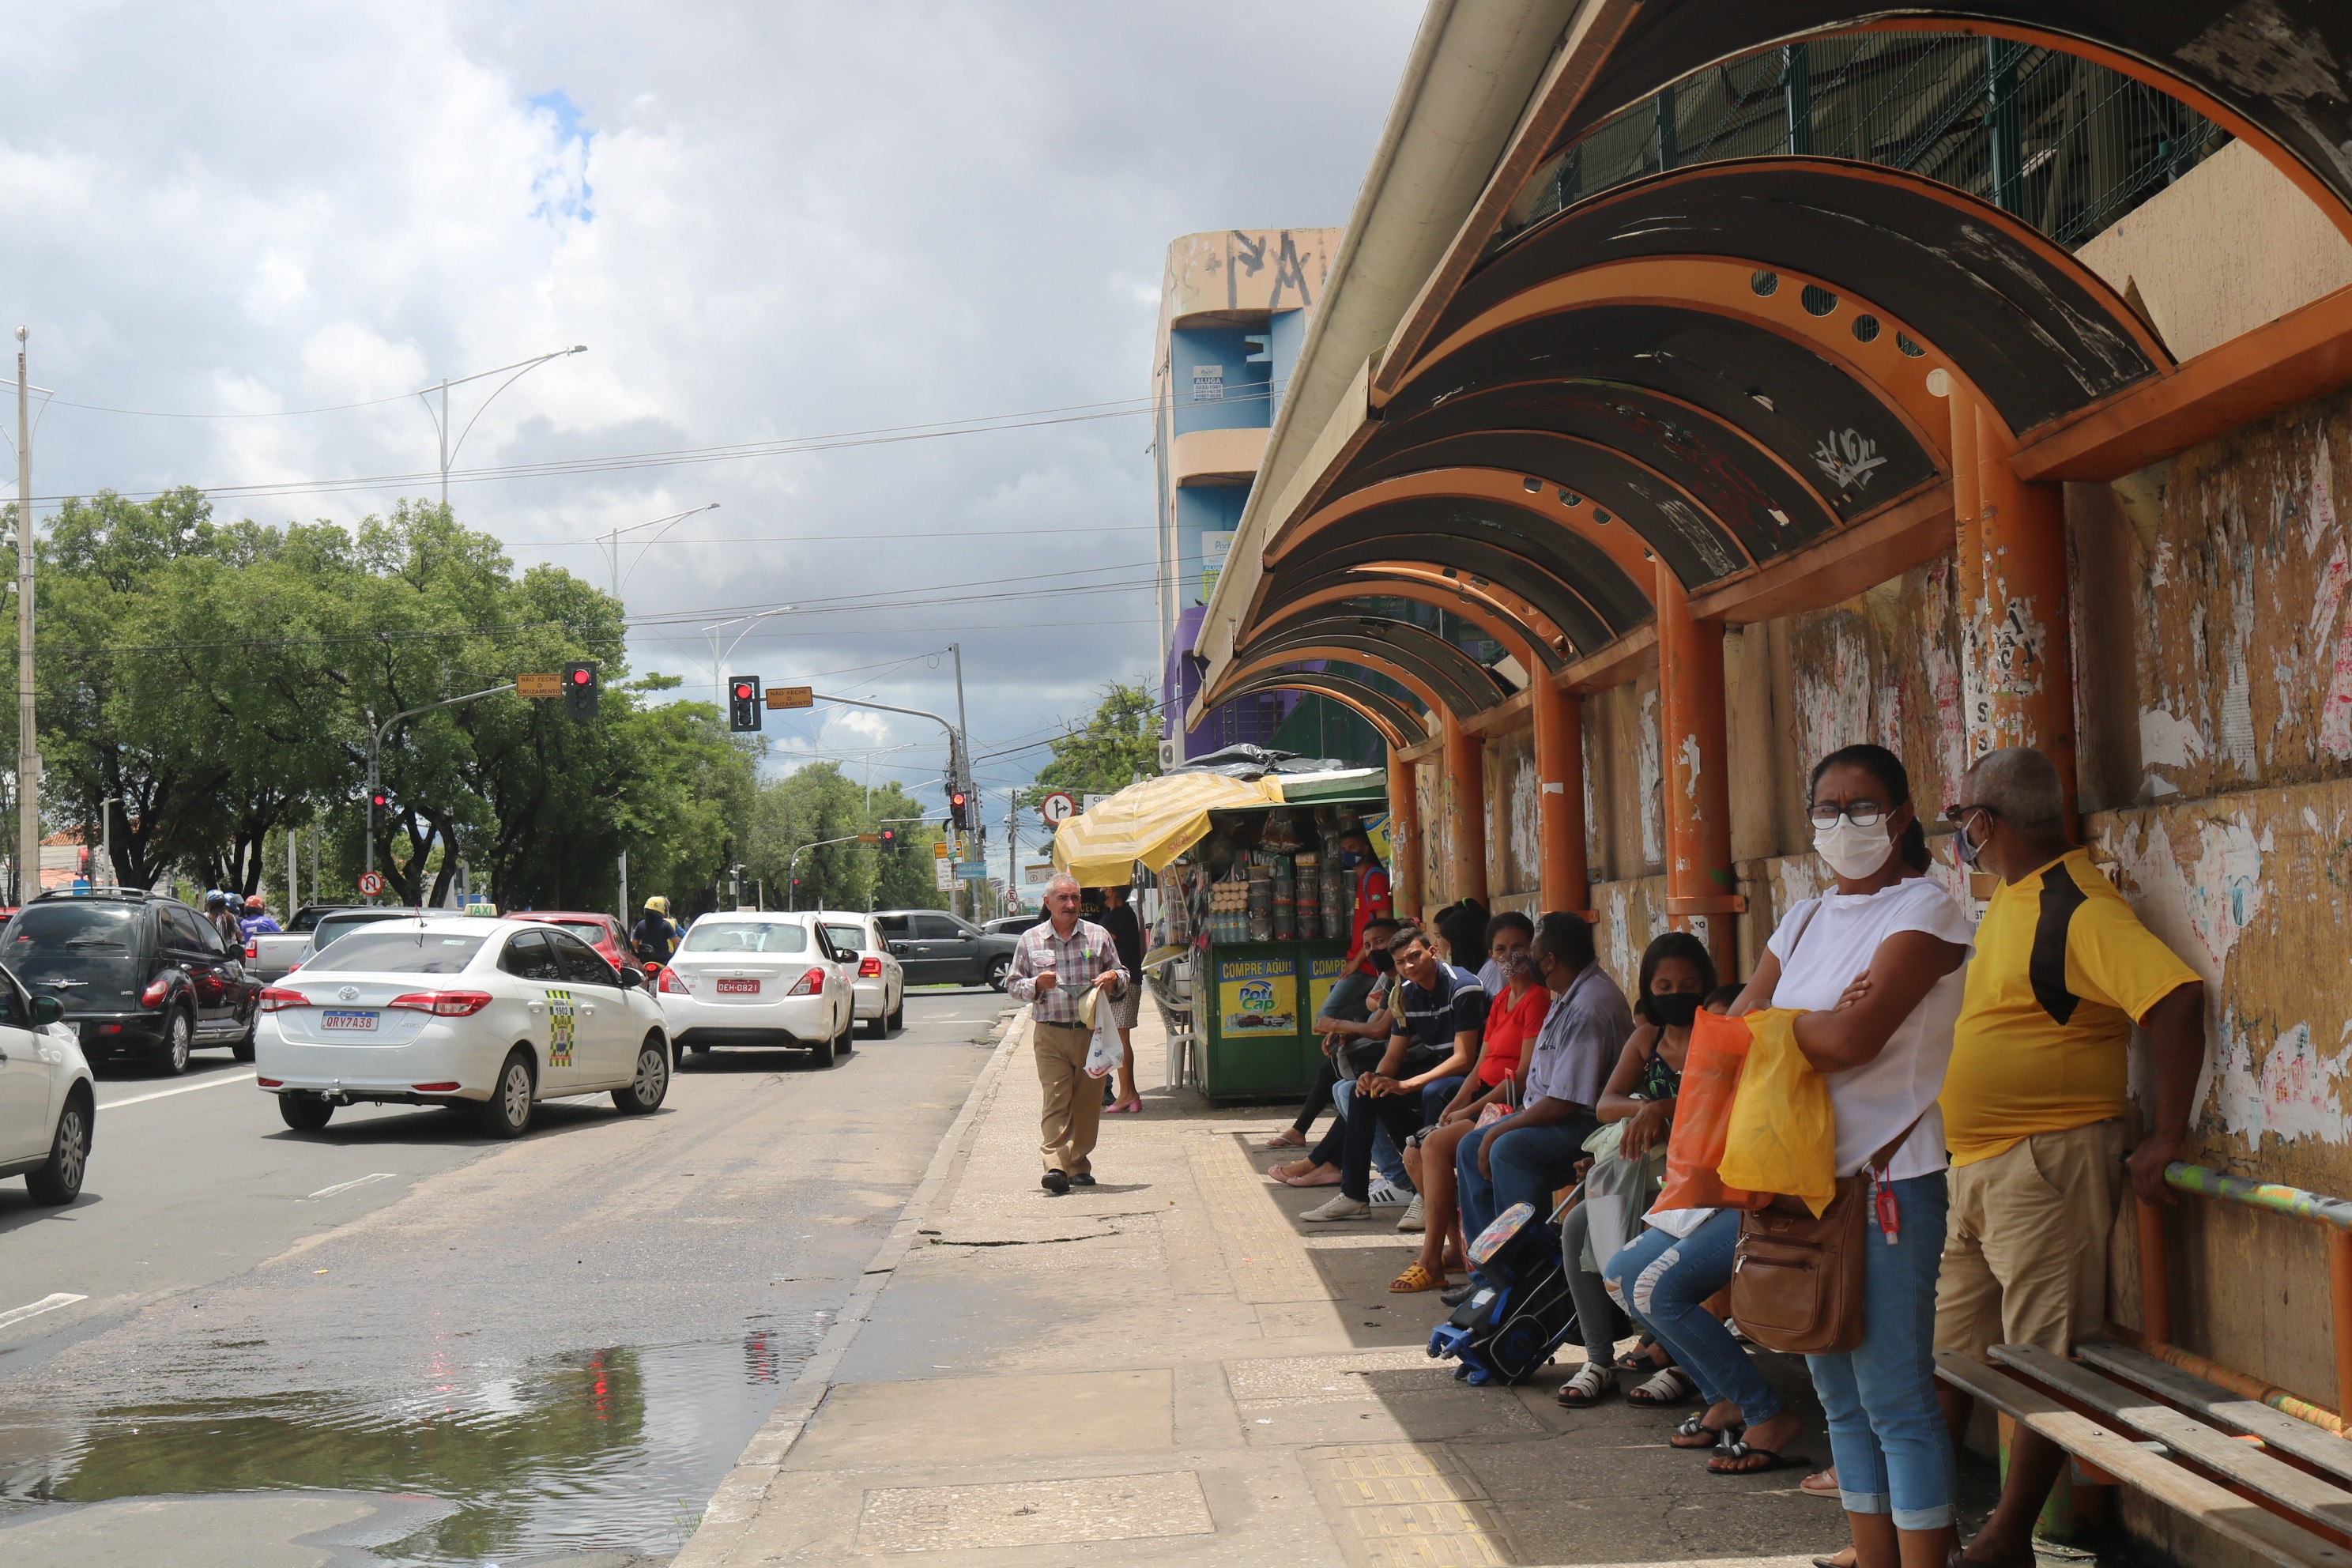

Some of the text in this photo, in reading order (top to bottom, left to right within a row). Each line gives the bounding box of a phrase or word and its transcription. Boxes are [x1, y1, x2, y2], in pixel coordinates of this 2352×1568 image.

[1168, 834, 1191, 854] SKOL
[468, 905, 492, 916] TAXI
[1223, 960, 1291, 979] COMPRE AQUI!
[1238, 985, 1273, 1001] Poti
[556, 1006, 568, 1016] 1902
[1241, 997, 1276, 1013] Cap
[326, 1016, 372, 1028] QRY7A38
